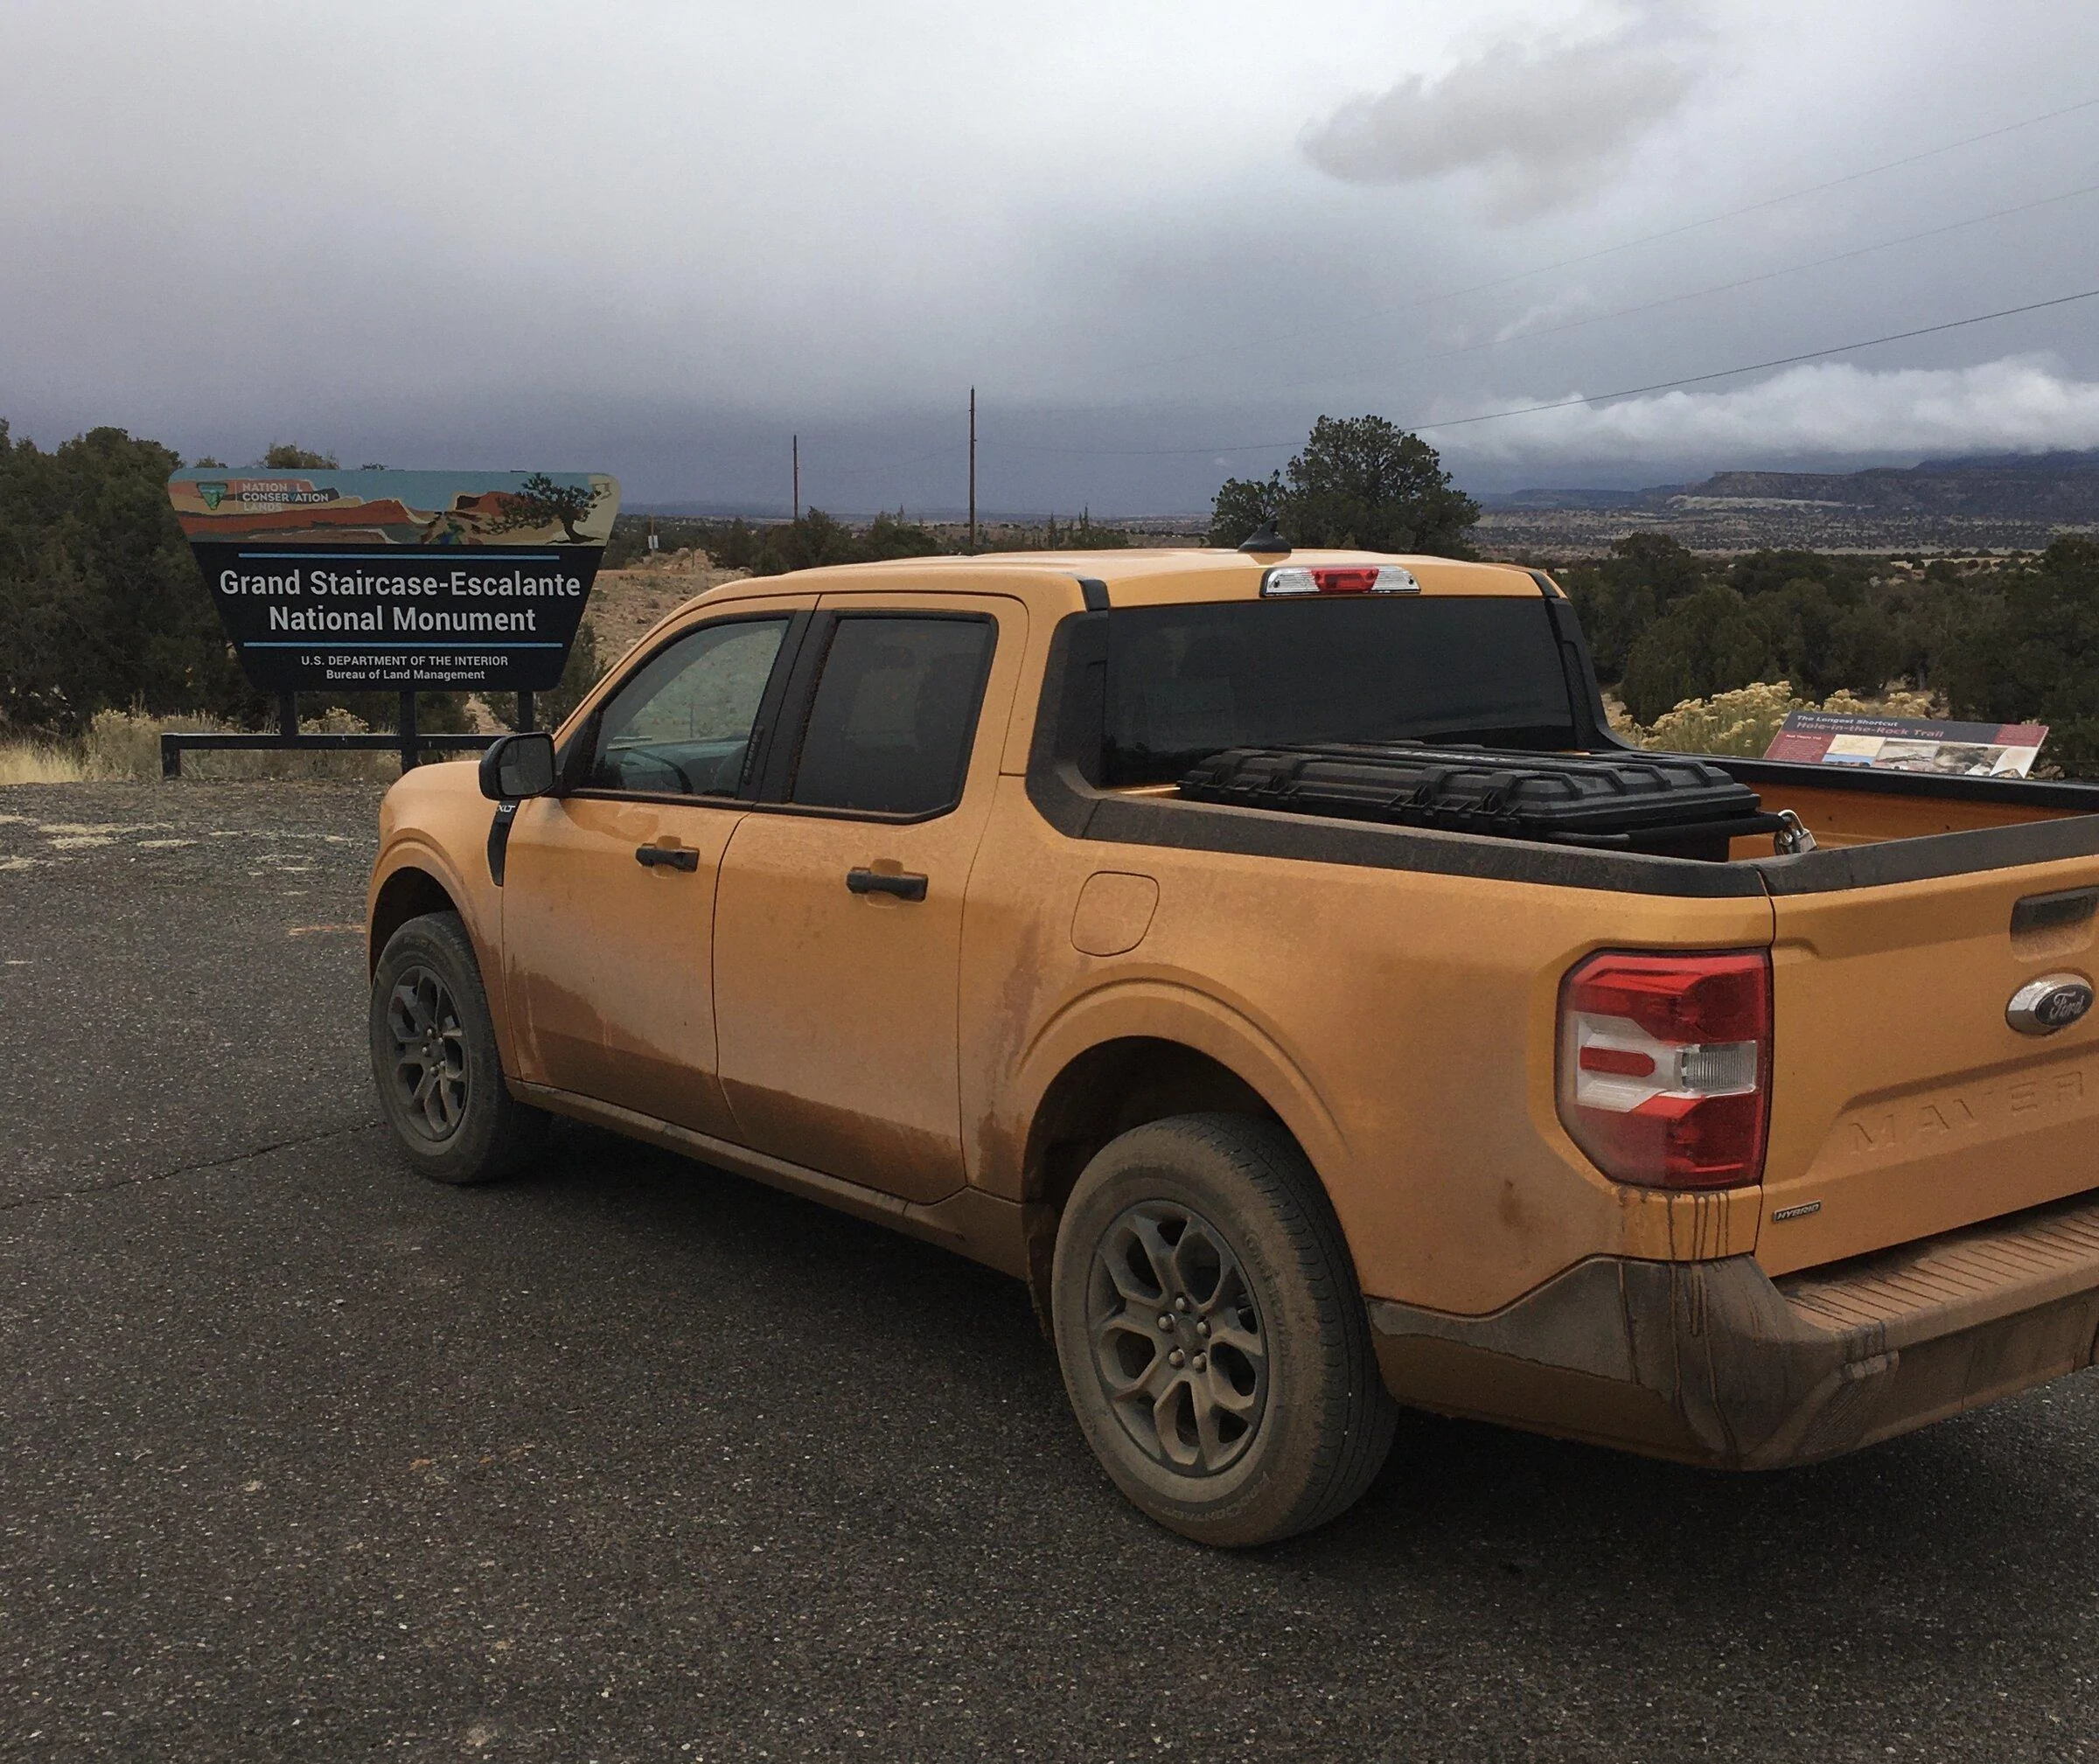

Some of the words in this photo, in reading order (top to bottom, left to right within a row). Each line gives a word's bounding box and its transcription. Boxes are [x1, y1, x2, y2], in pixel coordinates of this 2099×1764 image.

[242, 492, 329, 503] CONSERVATION
[243, 502, 282, 512] LANDS
[220, 569, 301, 596] Grand
[310, 569, 581, 597] Staircase-Escalante
[269, 605, 384, 631] National
[393, 606, 537, 632] Monument
[301, 655, 325, 666] U.S.
[328, 655, 407, 666] DEPARTMENT
[408, 656, 426, 666] OF
[429, 656, 452, 666] THE
[454, 656, 508, 666] INTERIOR
[326, 670, 366, 680] Bureau
[367, 670, 381, 680] of
[383, 670, 411, 680] Land
[413, 670, 485, 682] Management
[1796, 722, 1908, 736] Hole-in-the-Rock
[1914, 729, 1944, 738] Trail
[2049, 991, 2085, 1019] Ford
[1776, 1203, 1819, 1220] HYBRID
